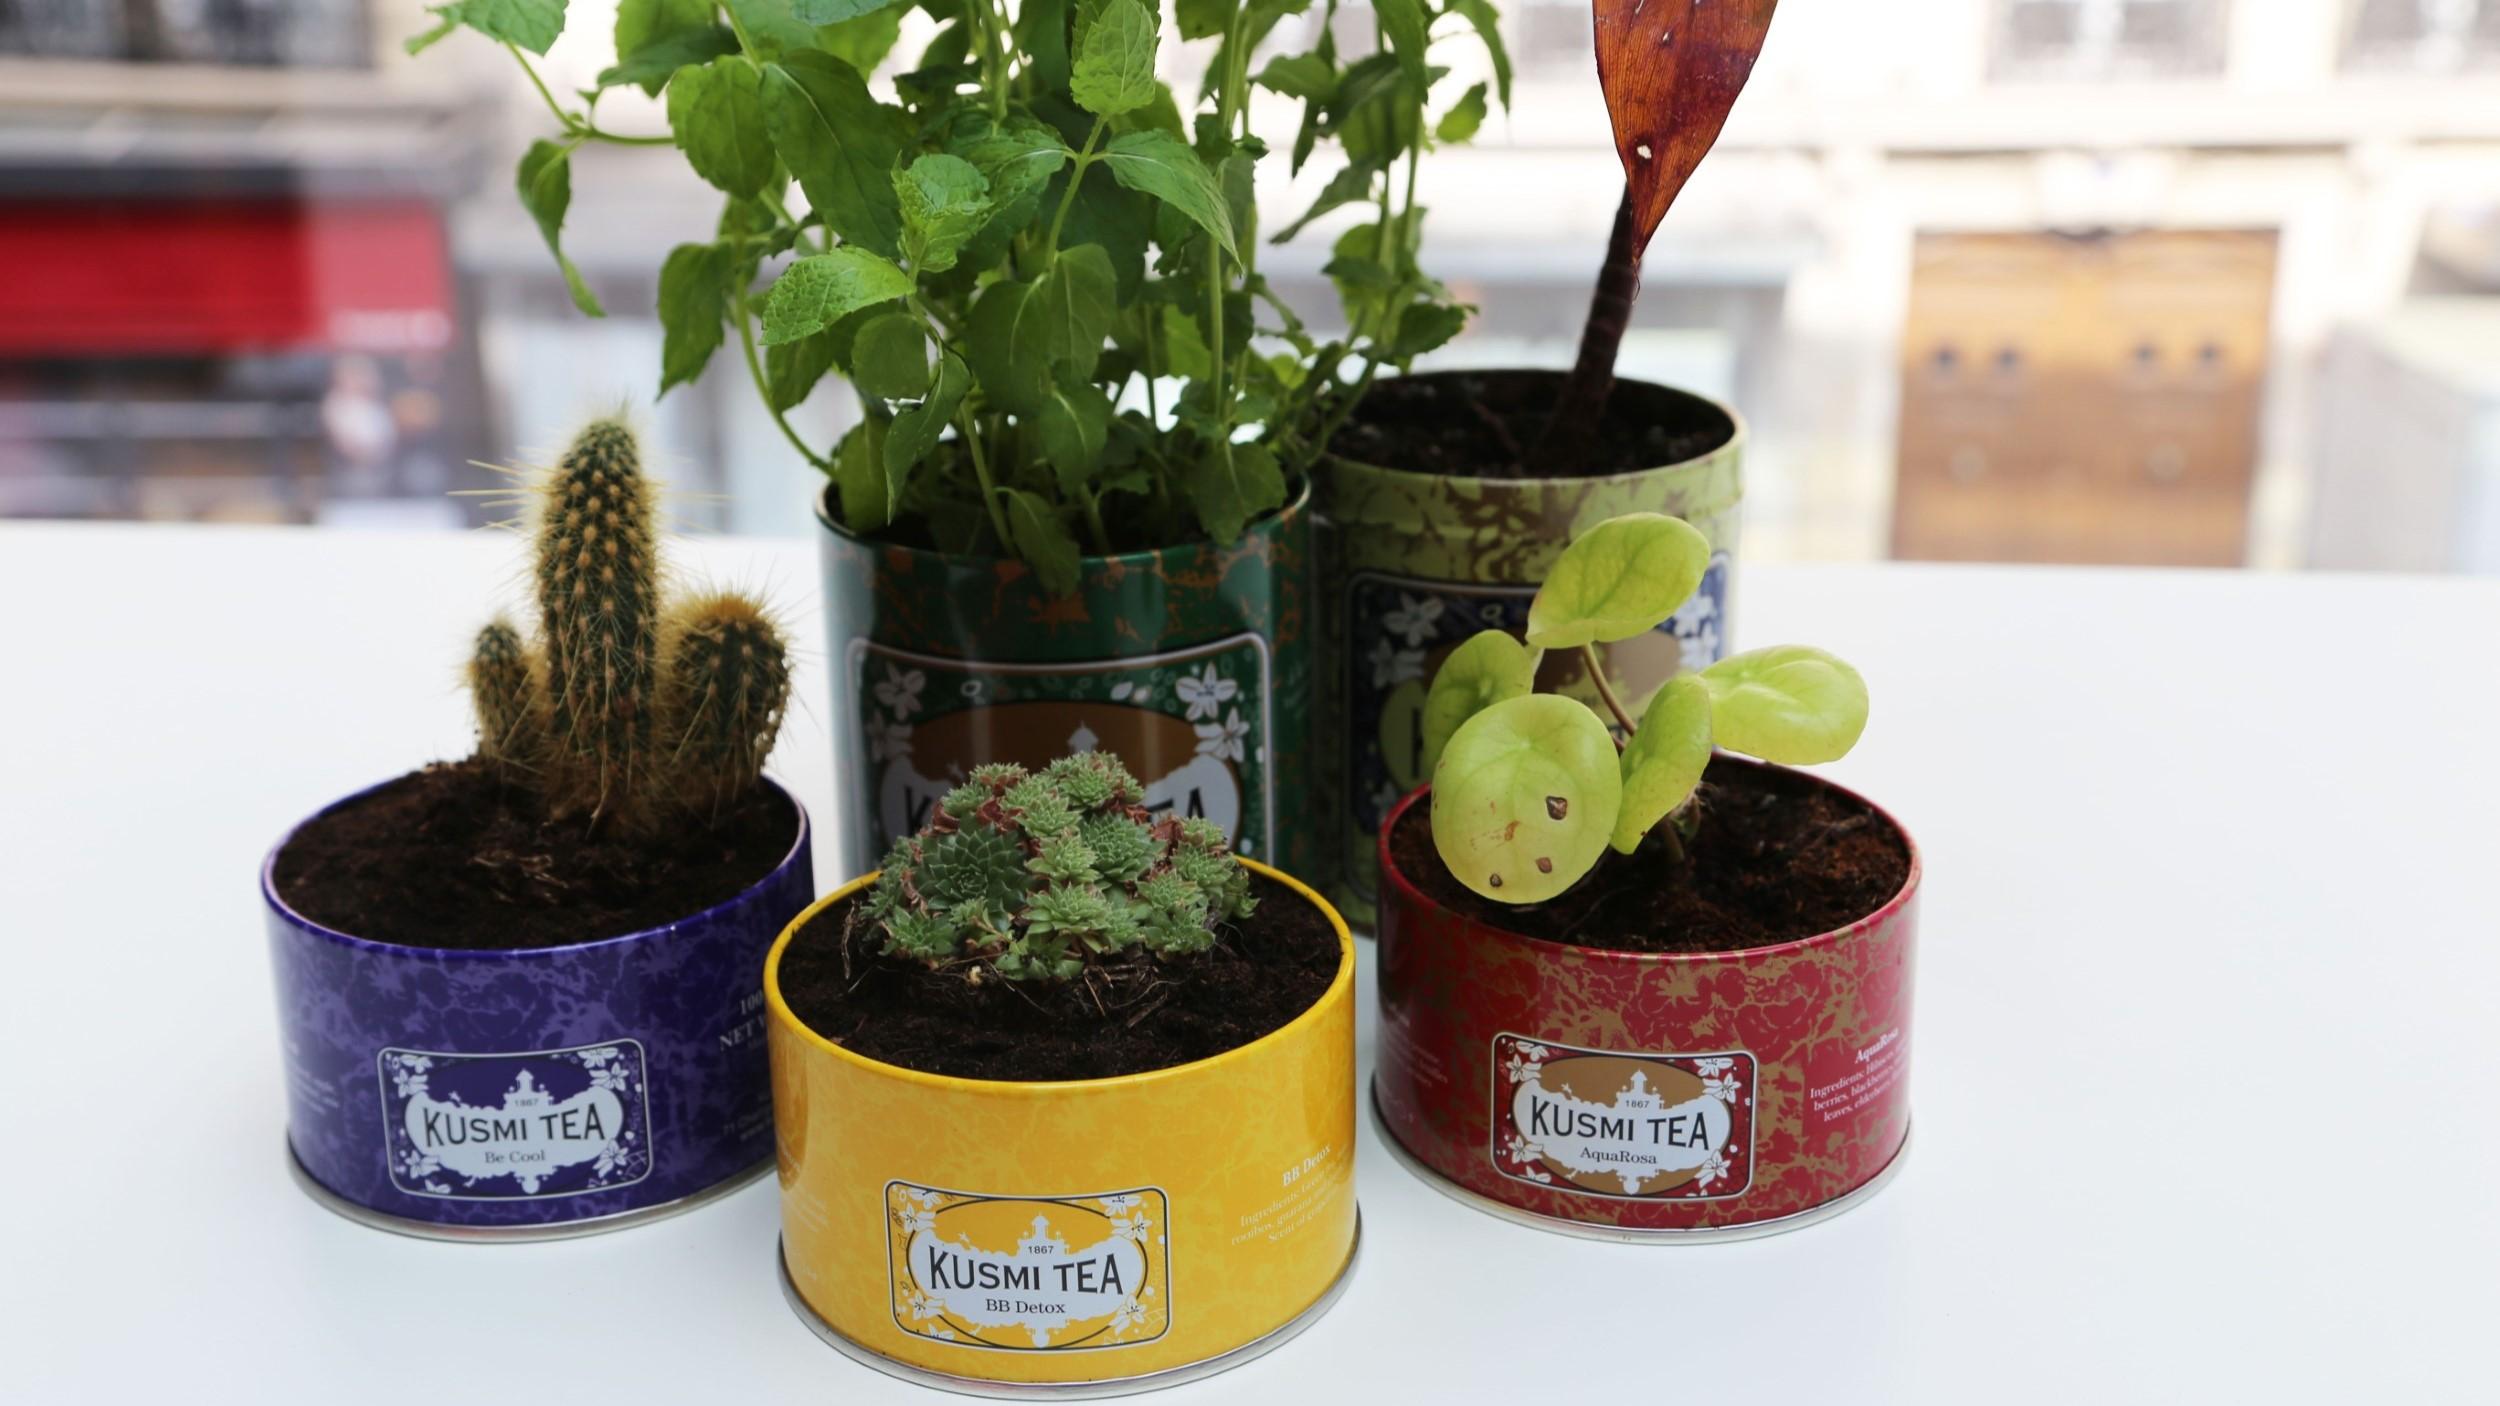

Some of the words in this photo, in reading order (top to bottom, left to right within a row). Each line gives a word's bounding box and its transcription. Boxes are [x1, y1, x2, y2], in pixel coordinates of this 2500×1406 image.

[1625, 1100, 1650, 1109] 1867
[422, 1106, 527, 1148] KUSMI
[539, 1102, 606, 1141] TEA
[1531, 1095, 1634, 1142] KUSMI
[1646, 1112, 1709, 1151] TEA
[484, 1150, 505, 1164] Be
[509, 1150, 546, 1163] Cool
[1580, 1147, 1657, 1165] AquaRosa
[1282, 1166, 1300, 1188] BB
[1028, 1245, 1054, 1255] 1867
[928, 1244, 1041, 1291] KUSMI
[1053, 1253, 1124, 1295] TEA
[986, 1298, 1011, 1313] BB
[1016, 1300, 1065, 1314] Detox
